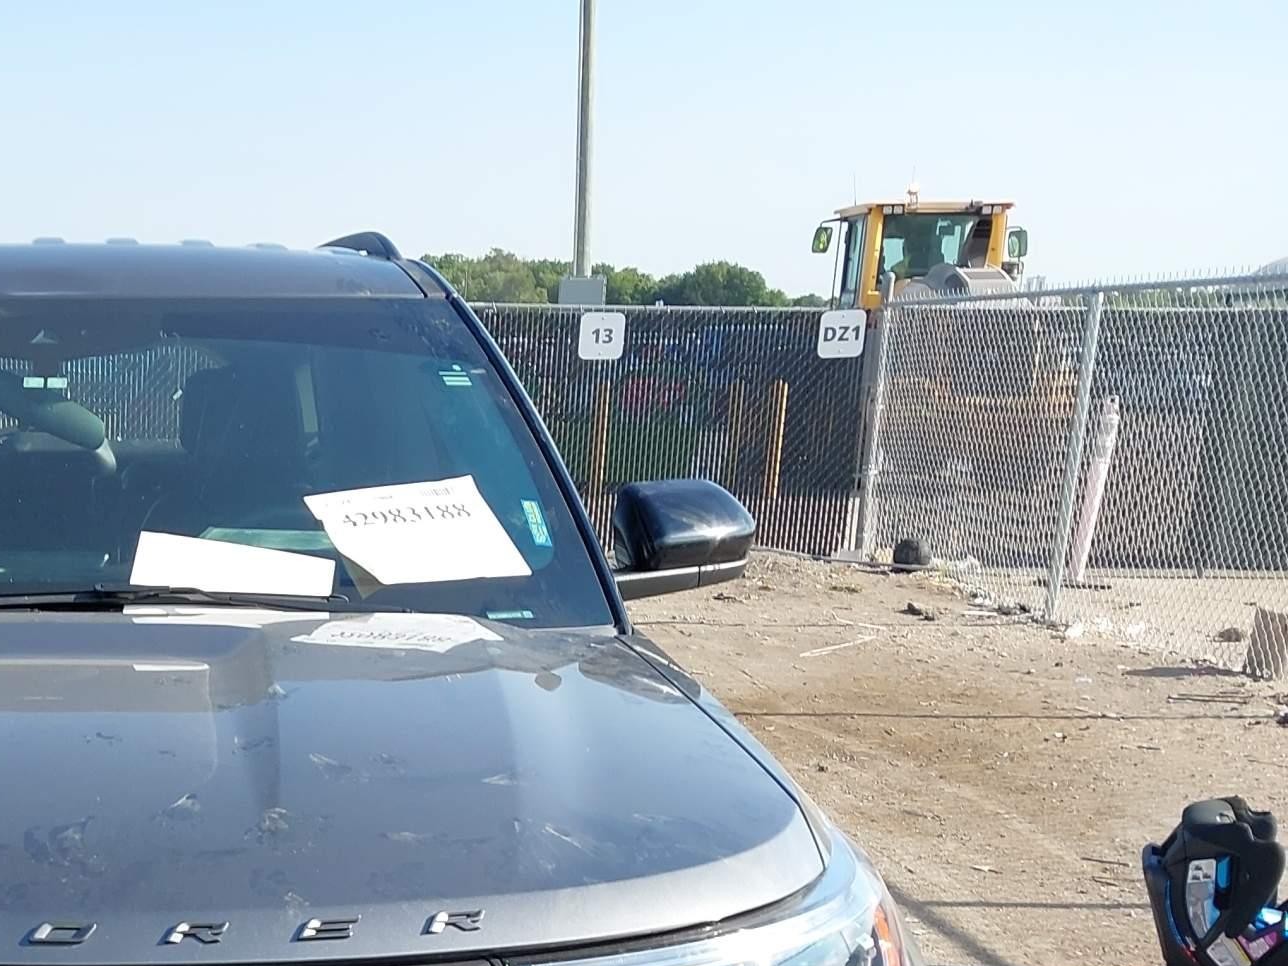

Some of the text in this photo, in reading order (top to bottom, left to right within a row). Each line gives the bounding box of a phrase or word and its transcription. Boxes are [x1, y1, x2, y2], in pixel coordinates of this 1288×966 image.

[591, 328, 614, 344] 13
[823, 325, 861, 342] DZ1
[342, 503, 472, 527] 42983188
